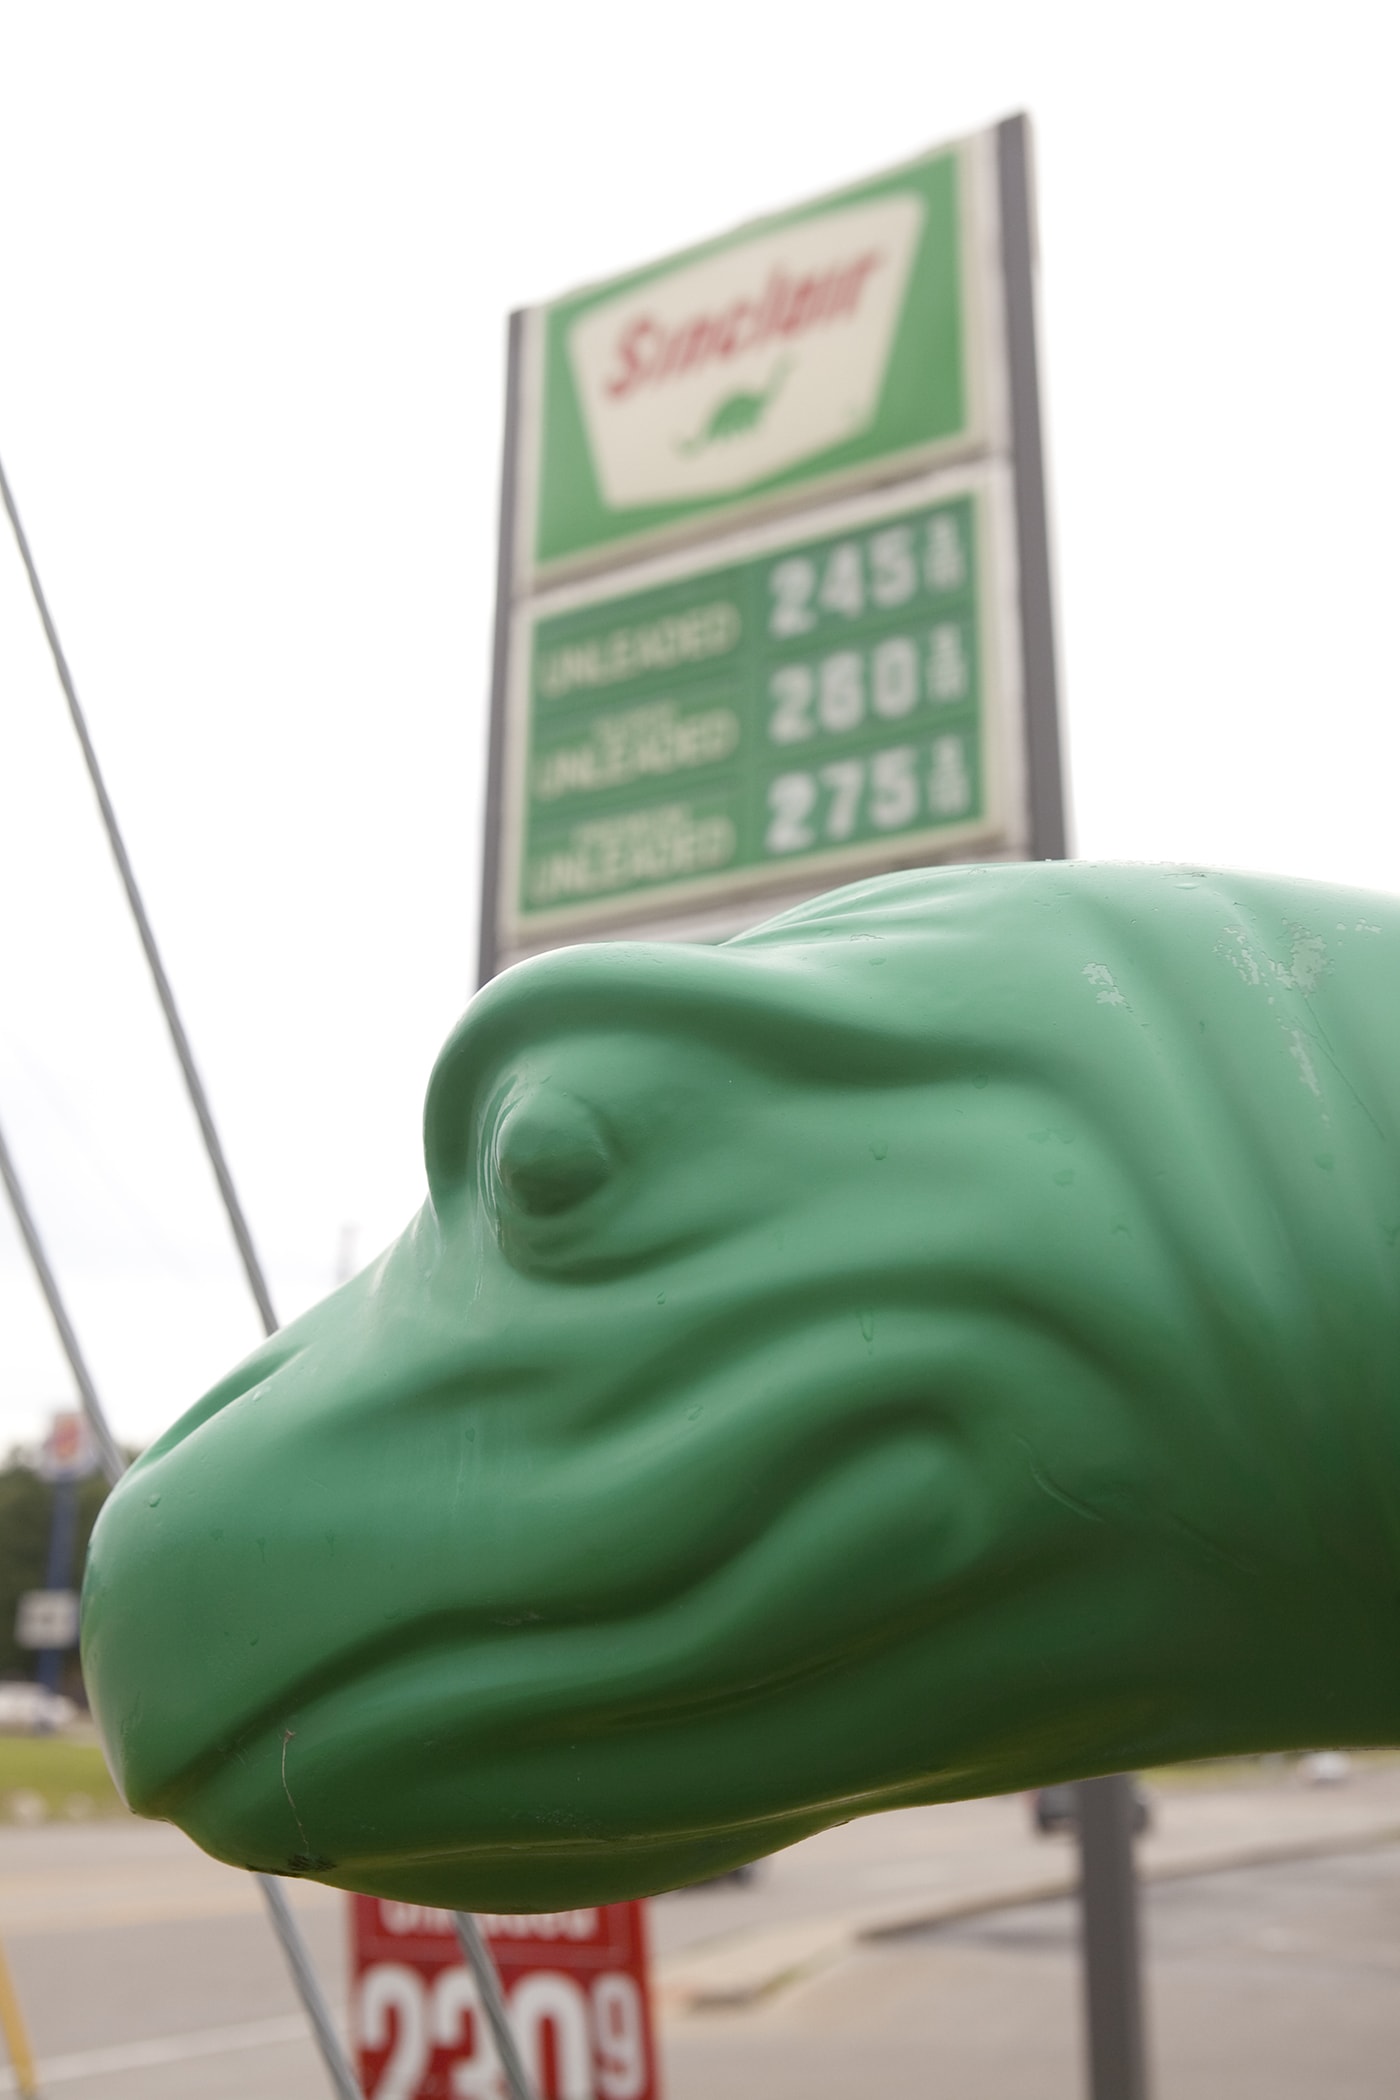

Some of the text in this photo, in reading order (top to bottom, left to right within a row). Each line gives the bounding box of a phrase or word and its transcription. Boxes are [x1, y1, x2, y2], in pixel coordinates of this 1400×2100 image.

[605, 248, 884, 398] Sinclair
[540, 602, 740, 696] UNLEADED
[769, 525, 919, 638] 245
[529, 816, 736, 904] UNLEADED
[765, 746, 919, 854] 275
[536, 708, 739, 798] UNLEADED
